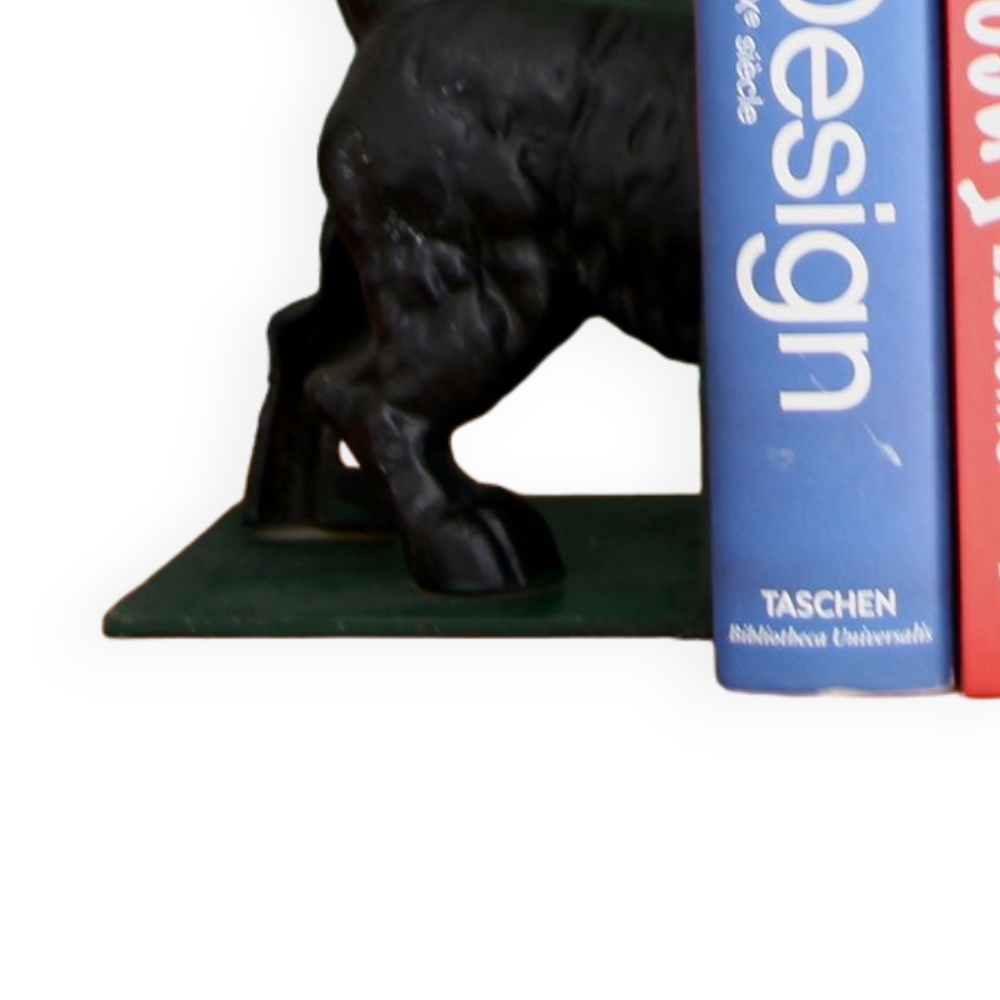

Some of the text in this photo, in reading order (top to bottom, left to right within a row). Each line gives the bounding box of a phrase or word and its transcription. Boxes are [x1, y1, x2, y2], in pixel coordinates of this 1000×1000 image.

[735, 34, 765, 125] siècle
[761, 588, 898, 619] TASCHEN
[729, 621, 934, 647] Bibliotheca Universalis
